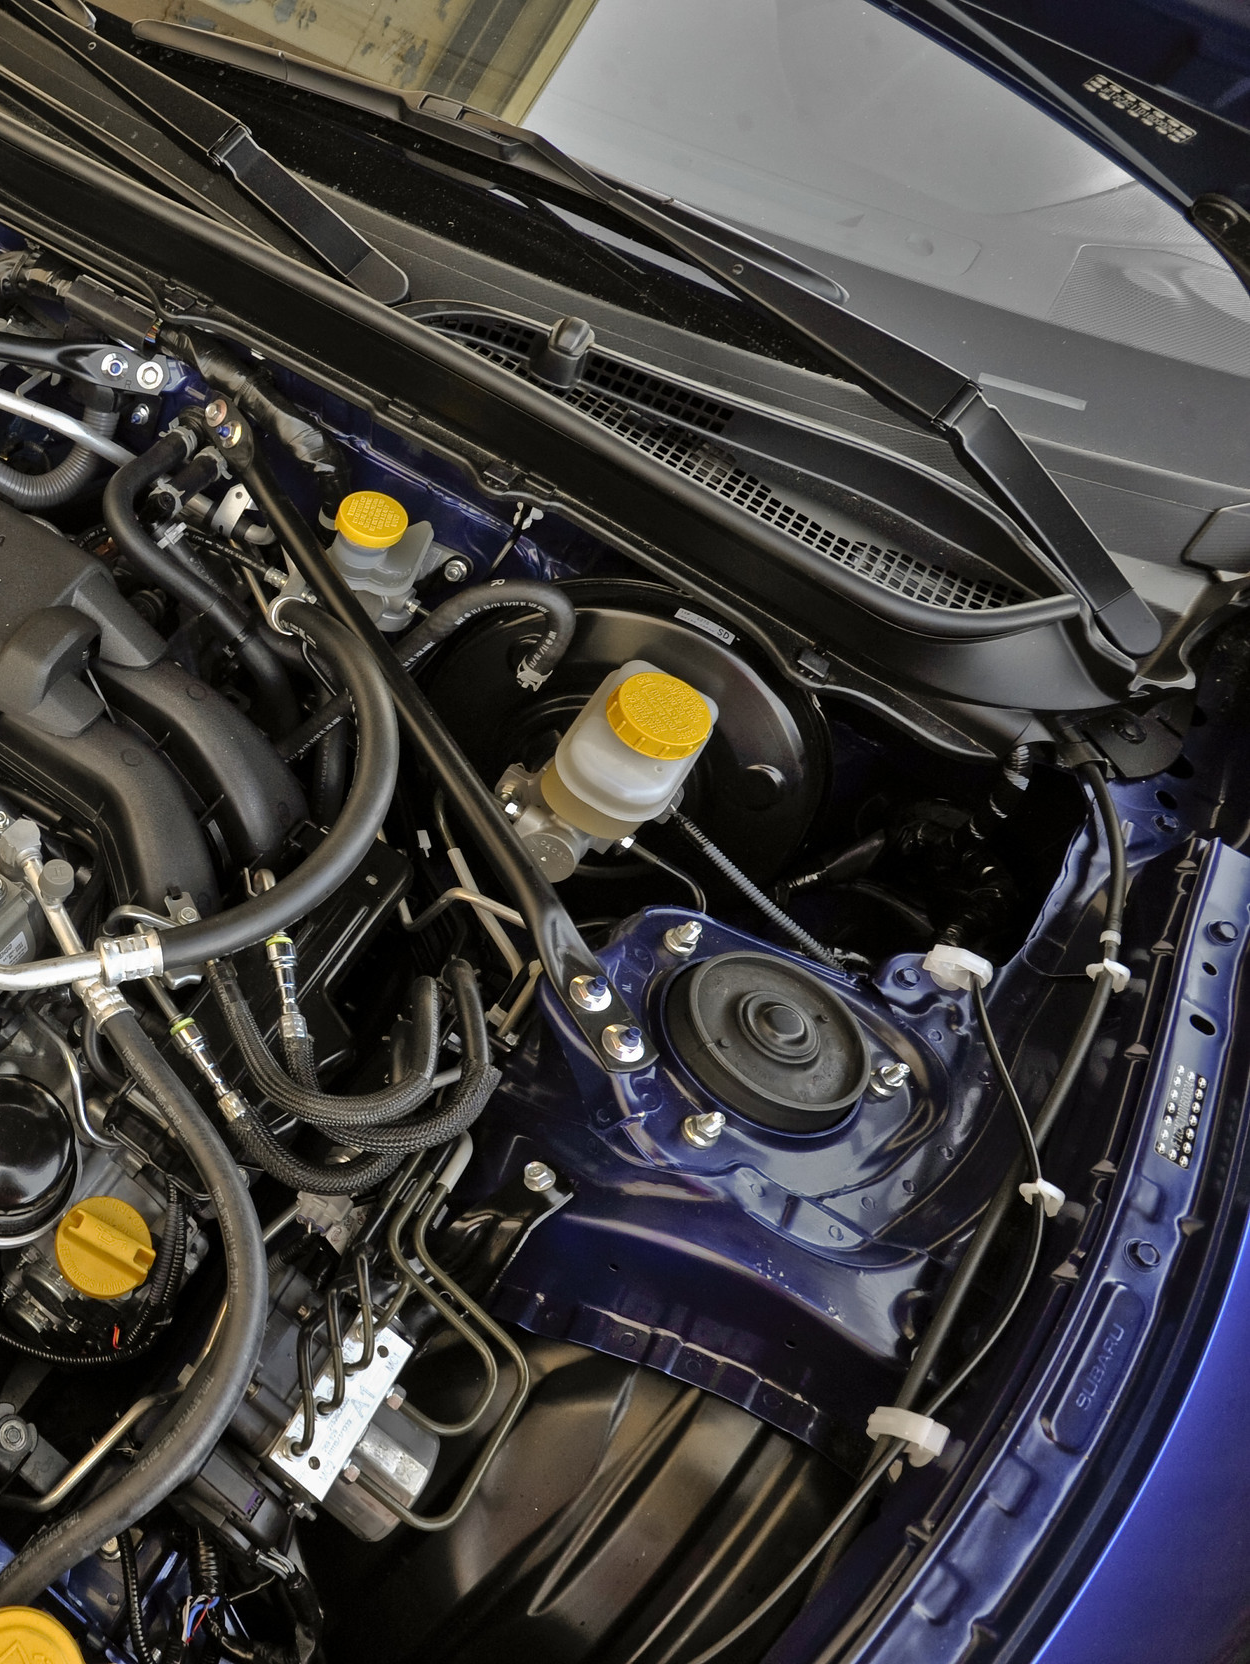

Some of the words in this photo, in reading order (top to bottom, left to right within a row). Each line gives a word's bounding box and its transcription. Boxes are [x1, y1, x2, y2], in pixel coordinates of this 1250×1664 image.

[490, 578, 506, 587] R
[716, 628, 730, 640] SD
[1076, 1323, 1125, 1411] SUBARU
